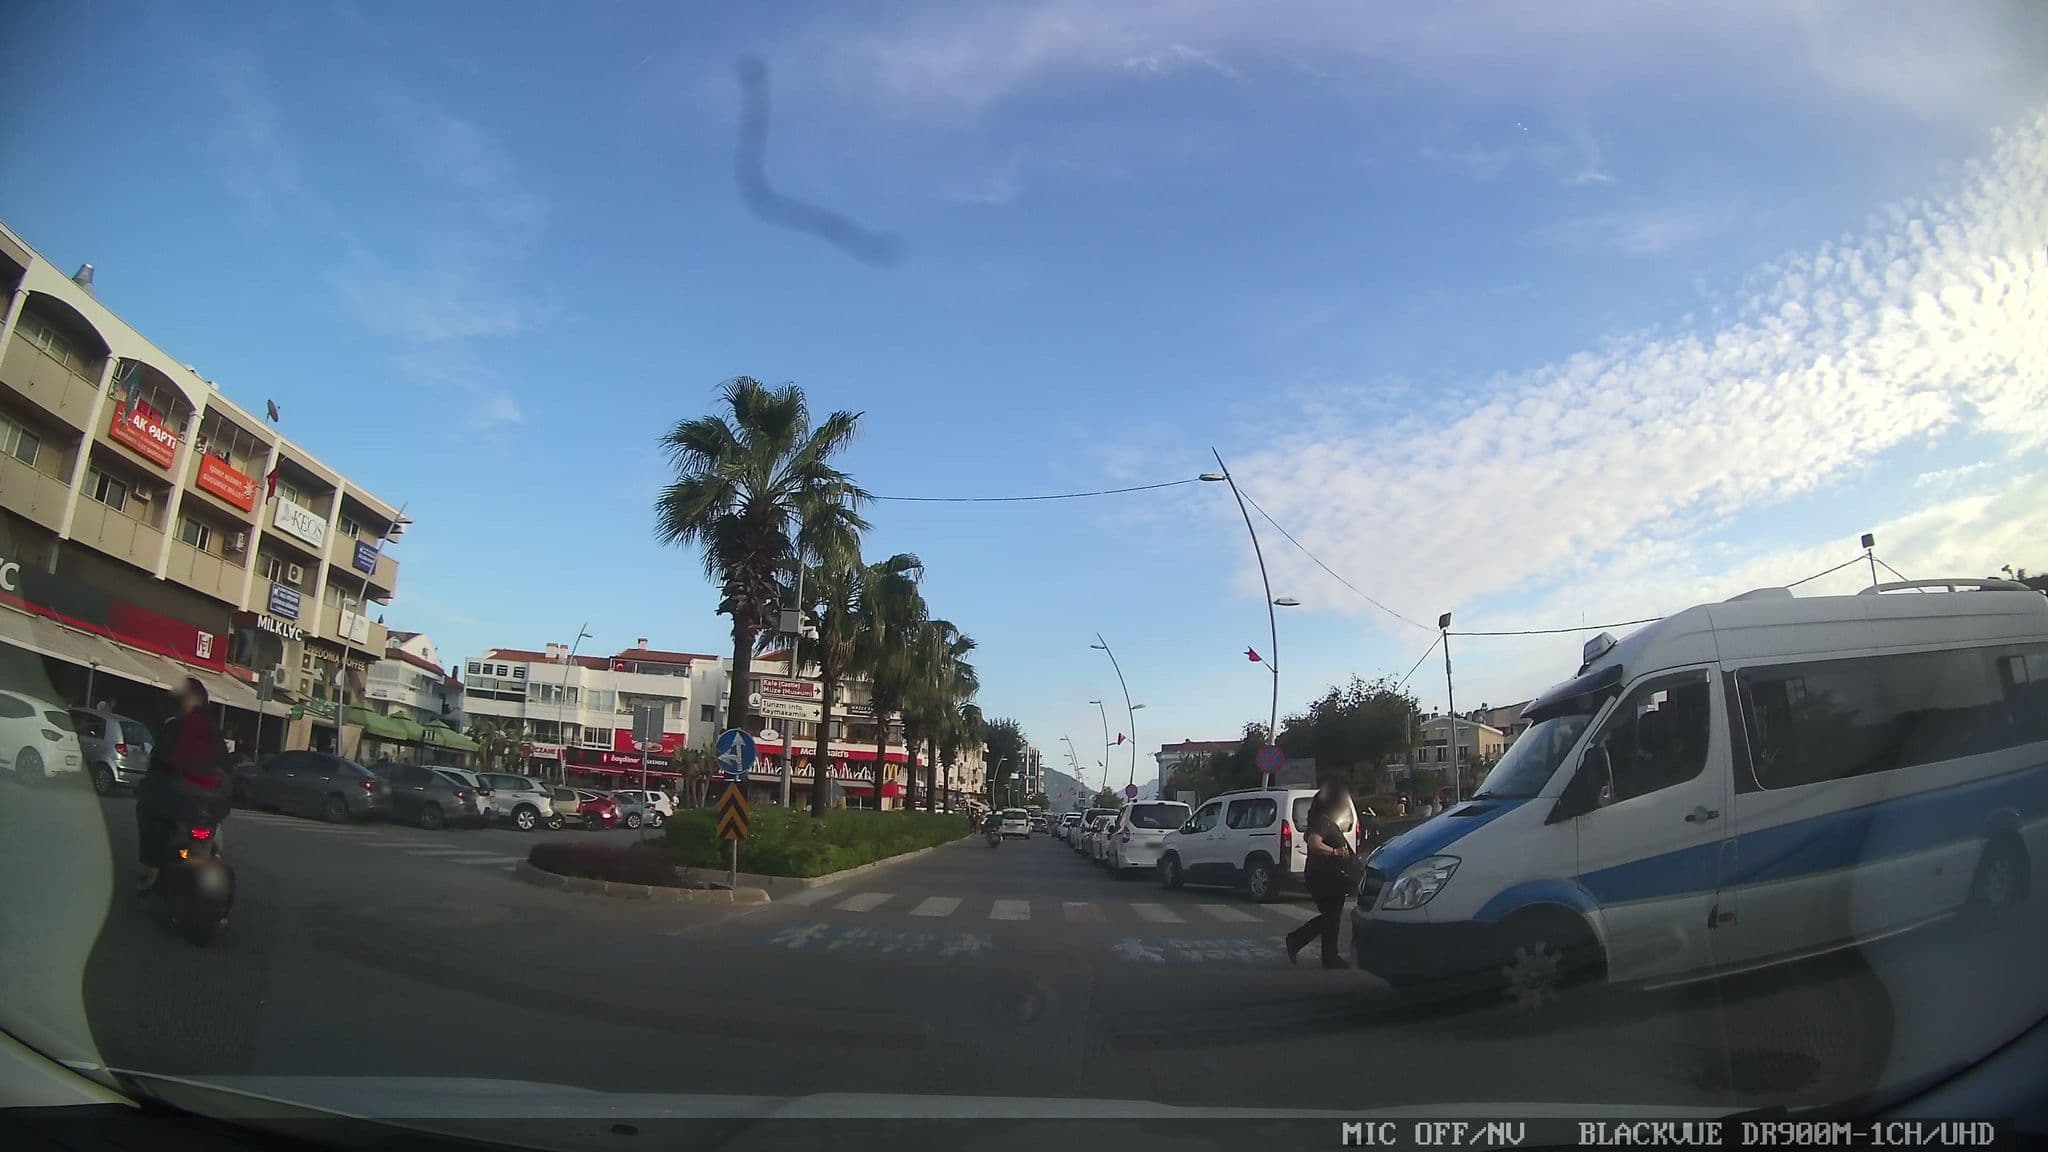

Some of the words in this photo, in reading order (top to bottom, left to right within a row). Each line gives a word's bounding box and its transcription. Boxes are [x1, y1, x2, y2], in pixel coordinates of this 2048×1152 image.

[133, 415, 146, 432] AK
[292, 510, 323, 538] KEOS
[763, 679, 778, 688] Kale
[778, 681, 801, 690] (Castle)
[763, 686, 782, 694] Müze
[782, 688, 813, 697] (Museum)
